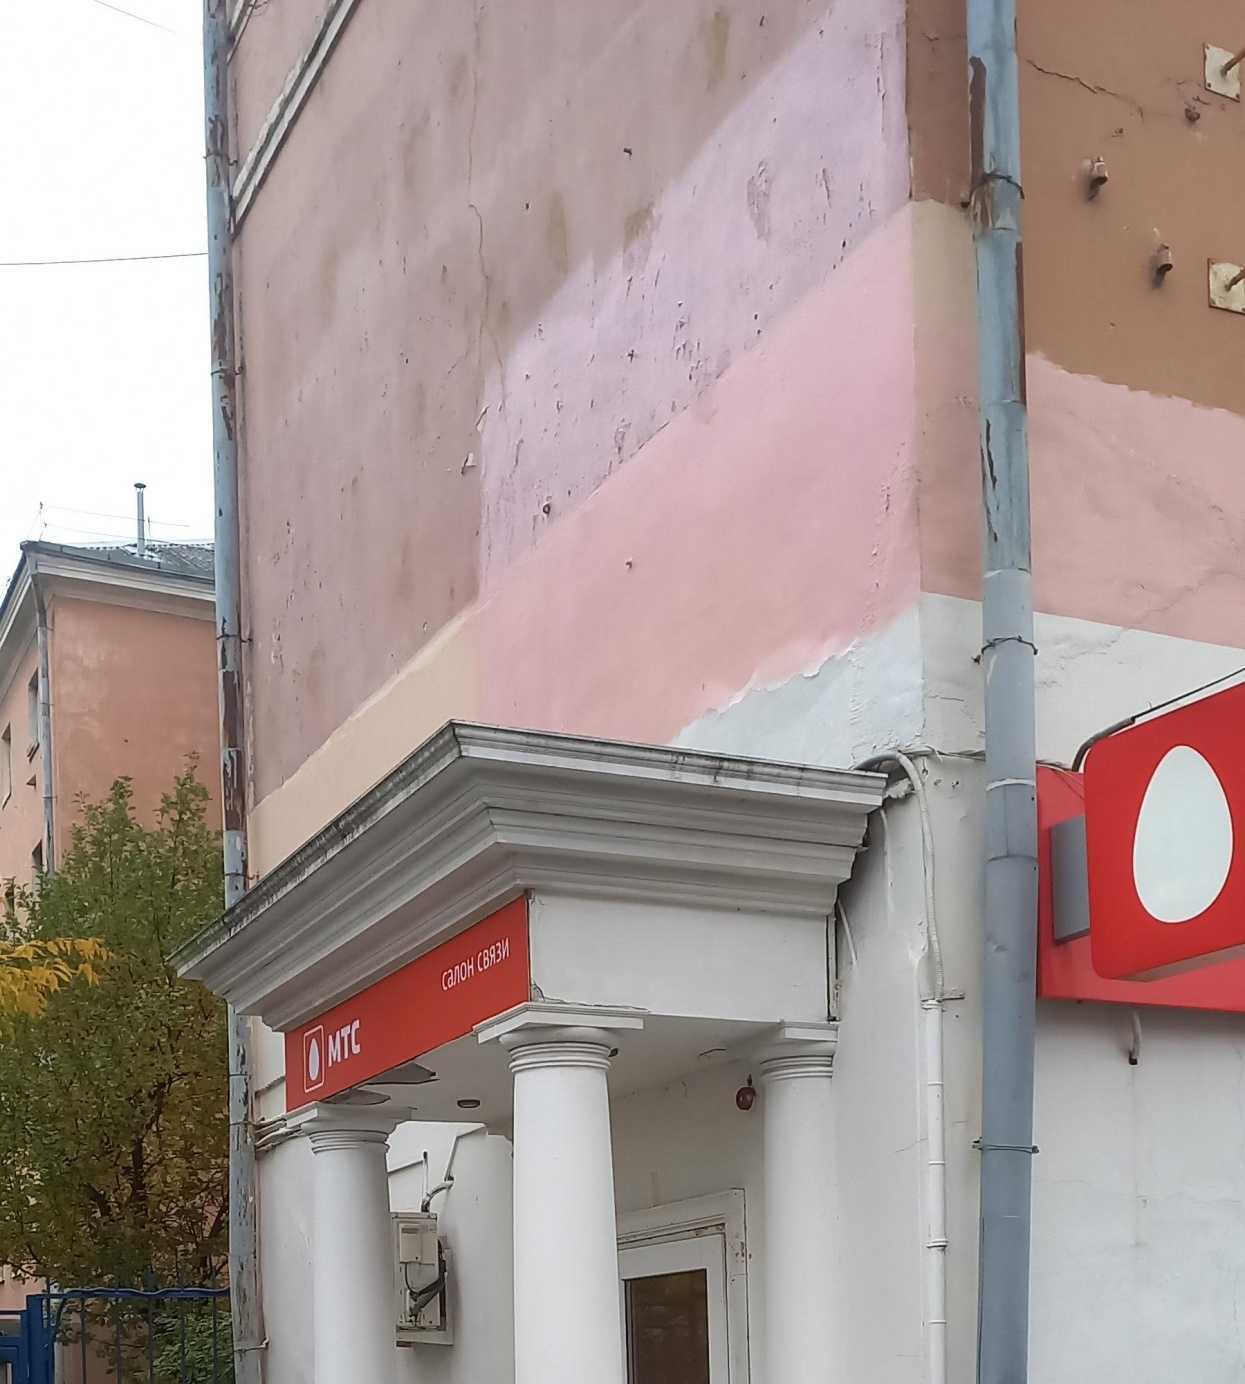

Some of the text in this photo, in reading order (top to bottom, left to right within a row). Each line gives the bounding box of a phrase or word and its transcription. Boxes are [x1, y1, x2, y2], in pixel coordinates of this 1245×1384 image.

[441, 937, 510, 991] салон связи
[327, 1019, 361, 1067] МТС
